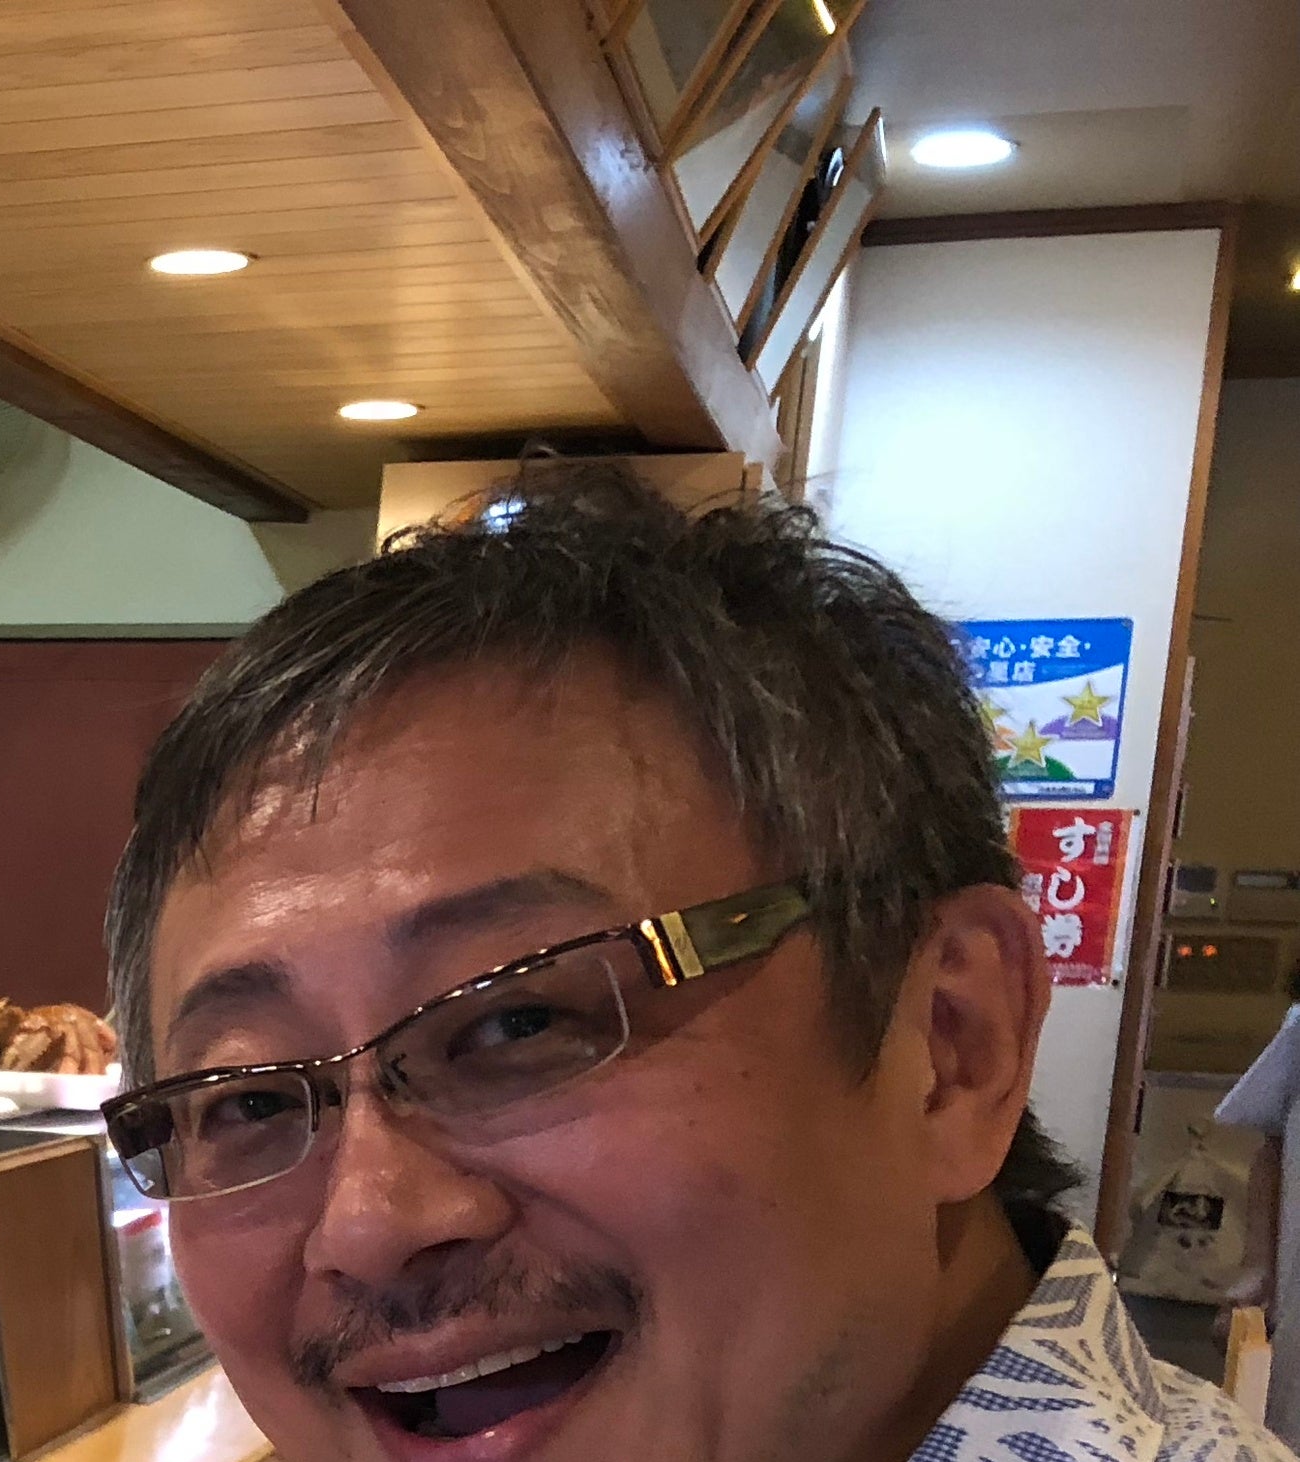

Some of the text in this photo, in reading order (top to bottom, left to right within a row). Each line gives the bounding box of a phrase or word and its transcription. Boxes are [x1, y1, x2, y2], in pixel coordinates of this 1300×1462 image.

[951, 634, 1091, 659] 安心・安全・
